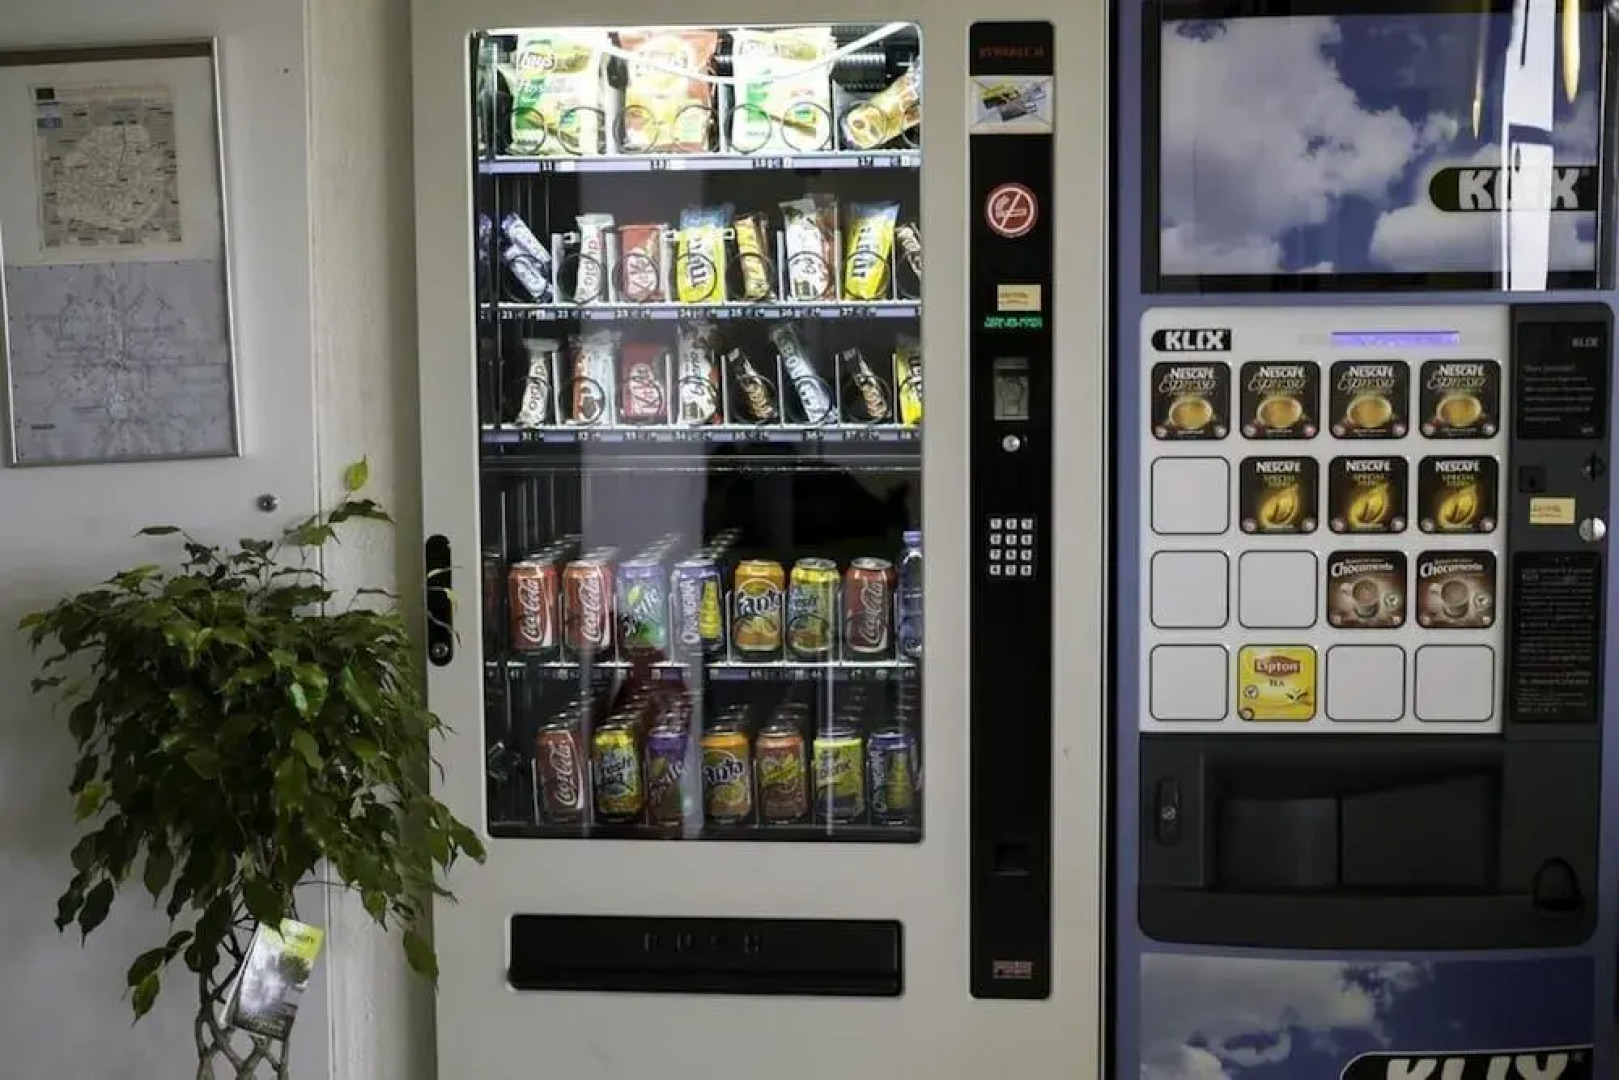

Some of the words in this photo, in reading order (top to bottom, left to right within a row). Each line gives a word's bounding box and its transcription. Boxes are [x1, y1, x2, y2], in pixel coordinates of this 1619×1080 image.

[1165, 330, 1225, 350] KLIX
[518, 577, 543, 643] Coca-Cola
[578, 577, 602, 643] Coca-Cola
[859, 576, 883, 644] Coca-Cola
[1257, 662, 1299, 674] Lipton
[1269, 679, 1285, 687] TEA
[550, 740, 578, 806] Coca-Cola
